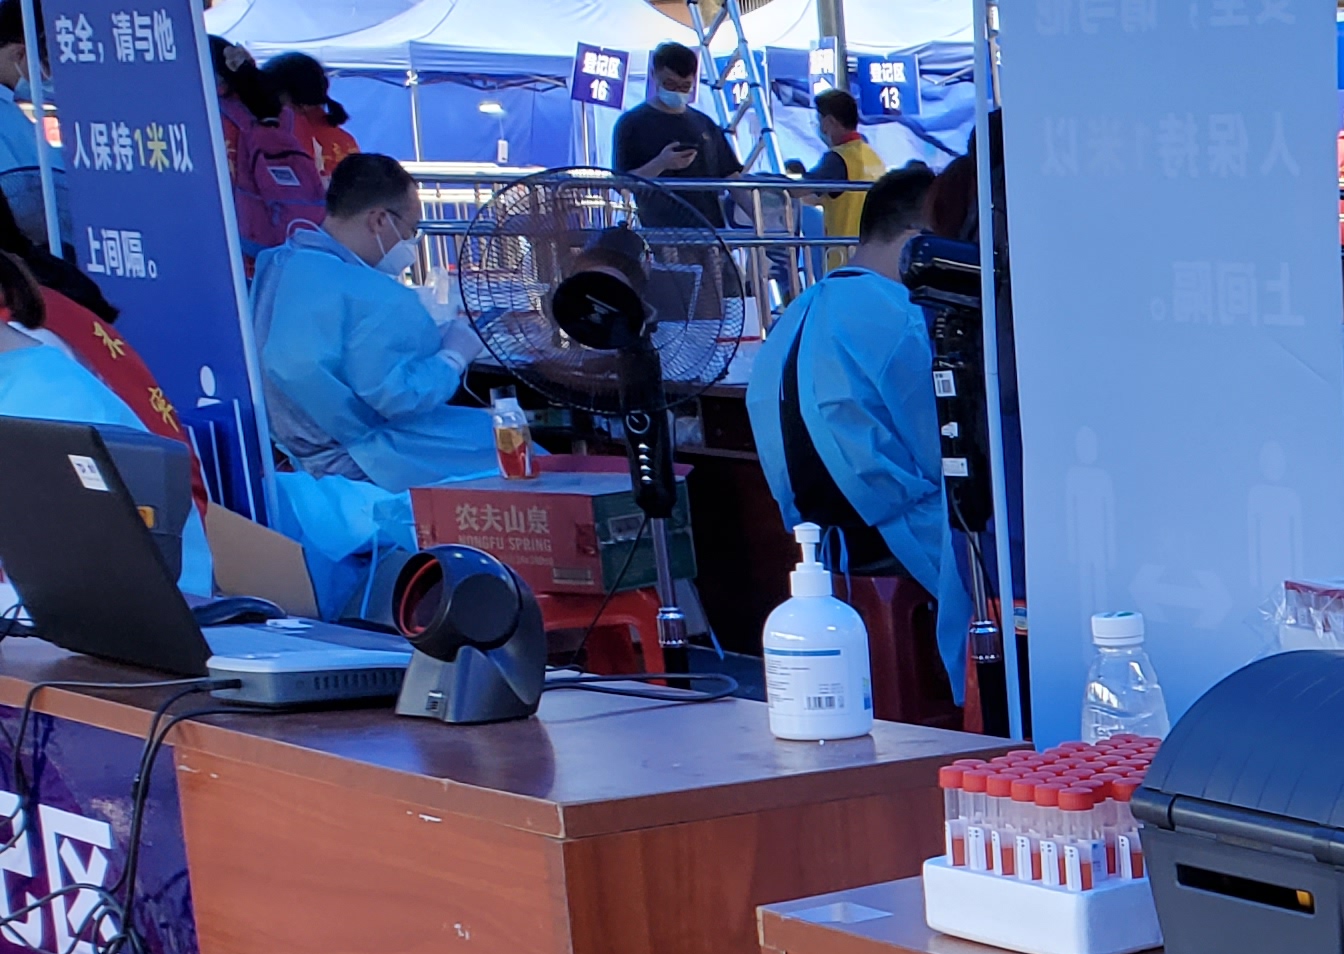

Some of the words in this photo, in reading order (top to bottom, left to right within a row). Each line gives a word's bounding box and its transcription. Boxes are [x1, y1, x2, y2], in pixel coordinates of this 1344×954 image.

[55, 8, 177, 64] 安全，请与他
[582, 51, 621, 80] 登记区
[869, 62, 907, 83] 登记区
[879, 87, 900, 109] 13
[73, 121, 194, 174] 人保持1米以
[87, 226, 159, 279] 上间隔。
[455, 503, 550, 534] 农夫山泉
[508, 537, 552, 552] SPRING
